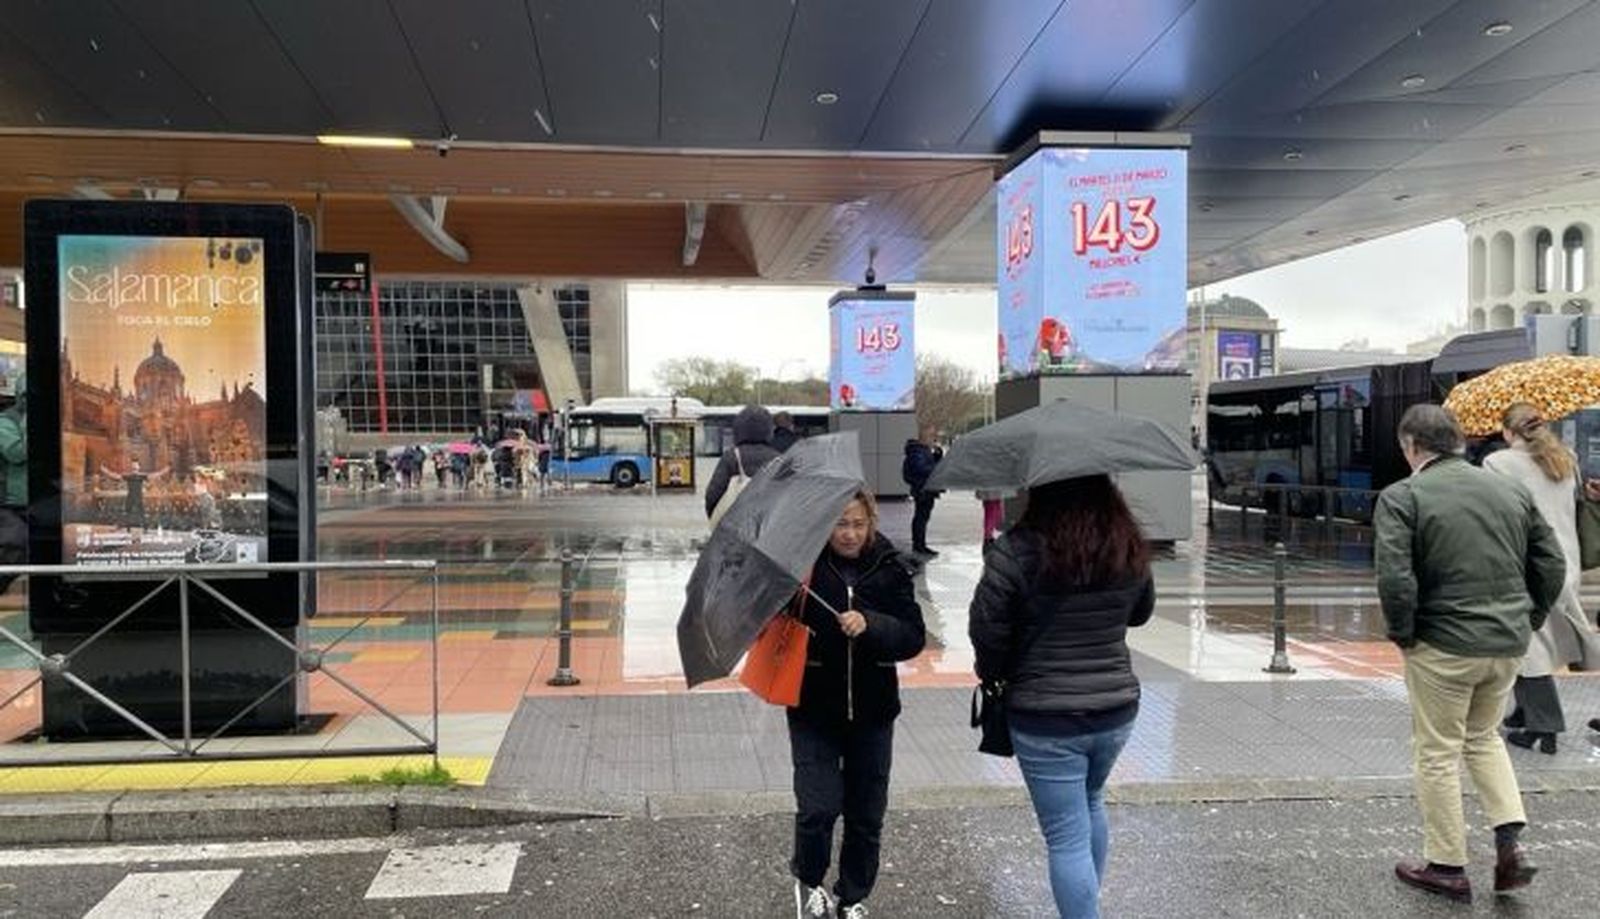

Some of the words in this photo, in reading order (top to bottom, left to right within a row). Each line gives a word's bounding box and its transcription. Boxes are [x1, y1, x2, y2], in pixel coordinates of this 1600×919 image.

[1071, 196, 1159, 255] 143
[67, 265, 259, 309] Salamanca
[174, 315, 212, 327] CIELO
[857, 322, 902, 353] 143
